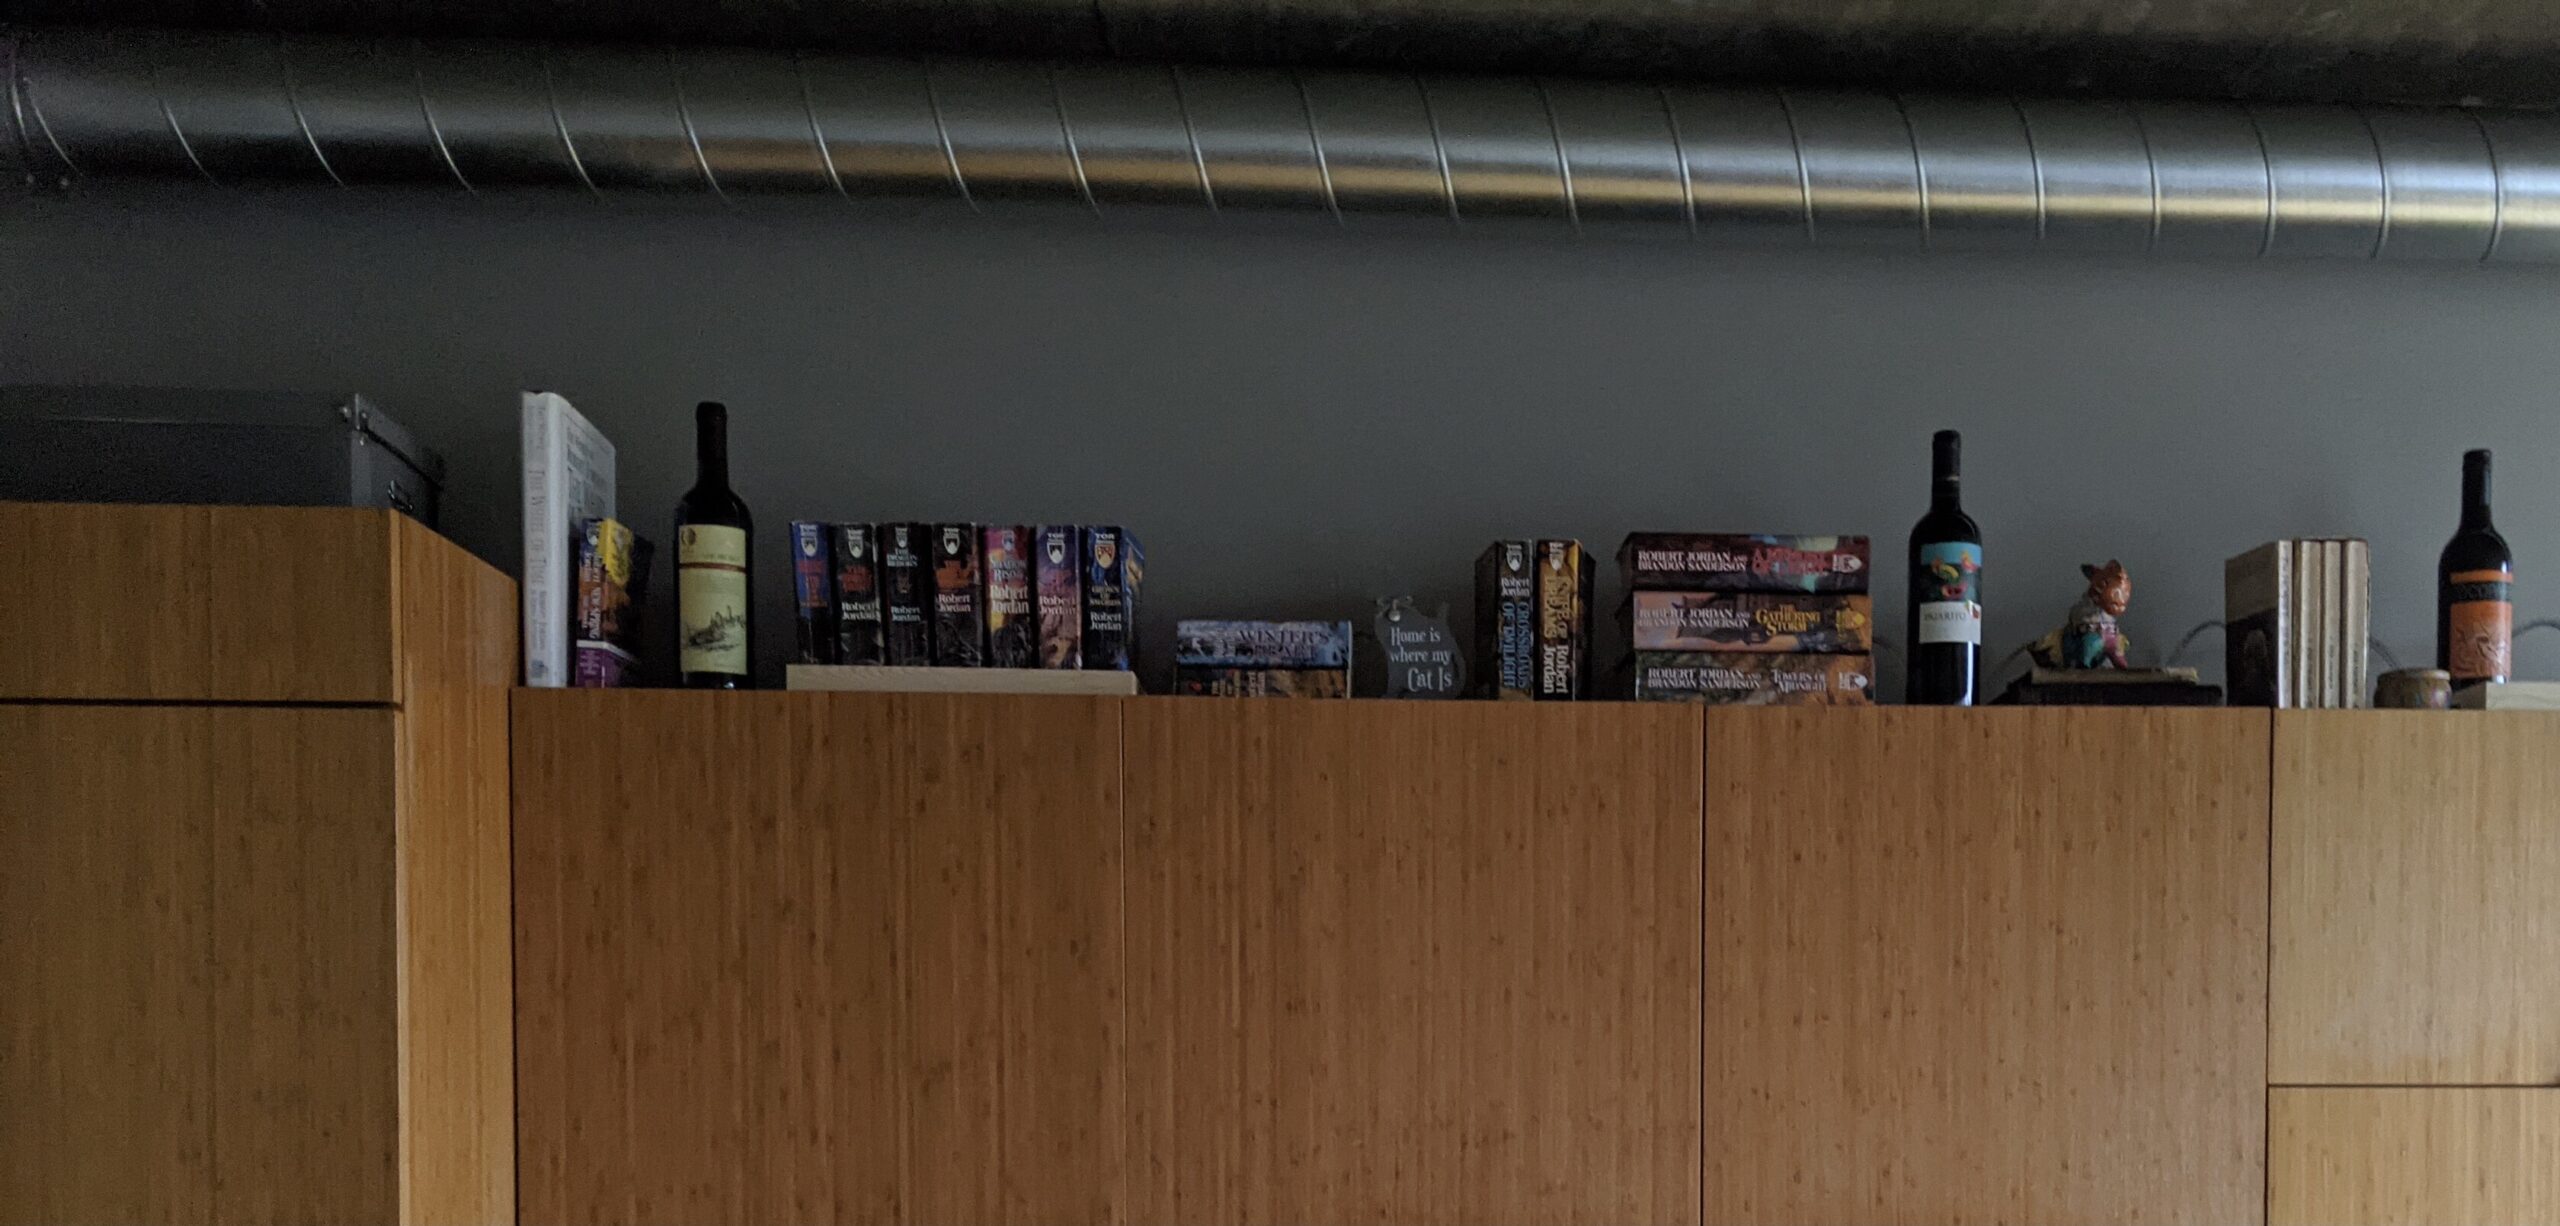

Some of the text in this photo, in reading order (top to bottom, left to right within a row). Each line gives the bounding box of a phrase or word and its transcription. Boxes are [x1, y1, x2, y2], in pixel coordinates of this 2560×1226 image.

[1638, 550, 1684, 561] ROBERT
[1687, 551, 1731, 562] JORDAN
[1638, 560, 1747, 572] BRANDON SANDERSON
[937, 592, 971, 603] Robert
[990, 584, 1028, 600] Robert
[890, 604, 921, 613] Robert
[937, 602, 972, 613] Jordan
[991, 600, 1030, 614] Jordan
[1639, 608, 1687, 618] ROBERT
[1689, 608, 1734, 618] JORDAN
[890, 612, 921, 622] Jordan
[1090, 611, 1122, 621] Robert
[1690, 617, 1750, 628] SANDERSON
[1755, 608, 1821, 624] GATHERING
[1090, 620, 1122, 631] Jordan
[1766, 621, 1808, 636] STORM
[1238, 629, 1330, 643] WINTER'S
[1390, 627, 1441, 646] Home is
[1503, 603, 1516, 688] OF TWILIGHT
[1517, 602, 1530, 688] CROSSROADS
[1390, 648, 1451, 666] where my
[1543, 644, 1556, 694] Jordan
[1556, 644, 1569, 694] Robert
[1648, 667, 1697, 678] ROBERT
[1699, 668, 1745, 679] JORDAN
[1771, 669, 1813, 682] TOWERS
[1407, 667, 1453, 692] Cat Is
[1648, 678, 1761, 690] BRANDON SANDERSON
[1778, 680, 1827, 693] MIDNIGHT
